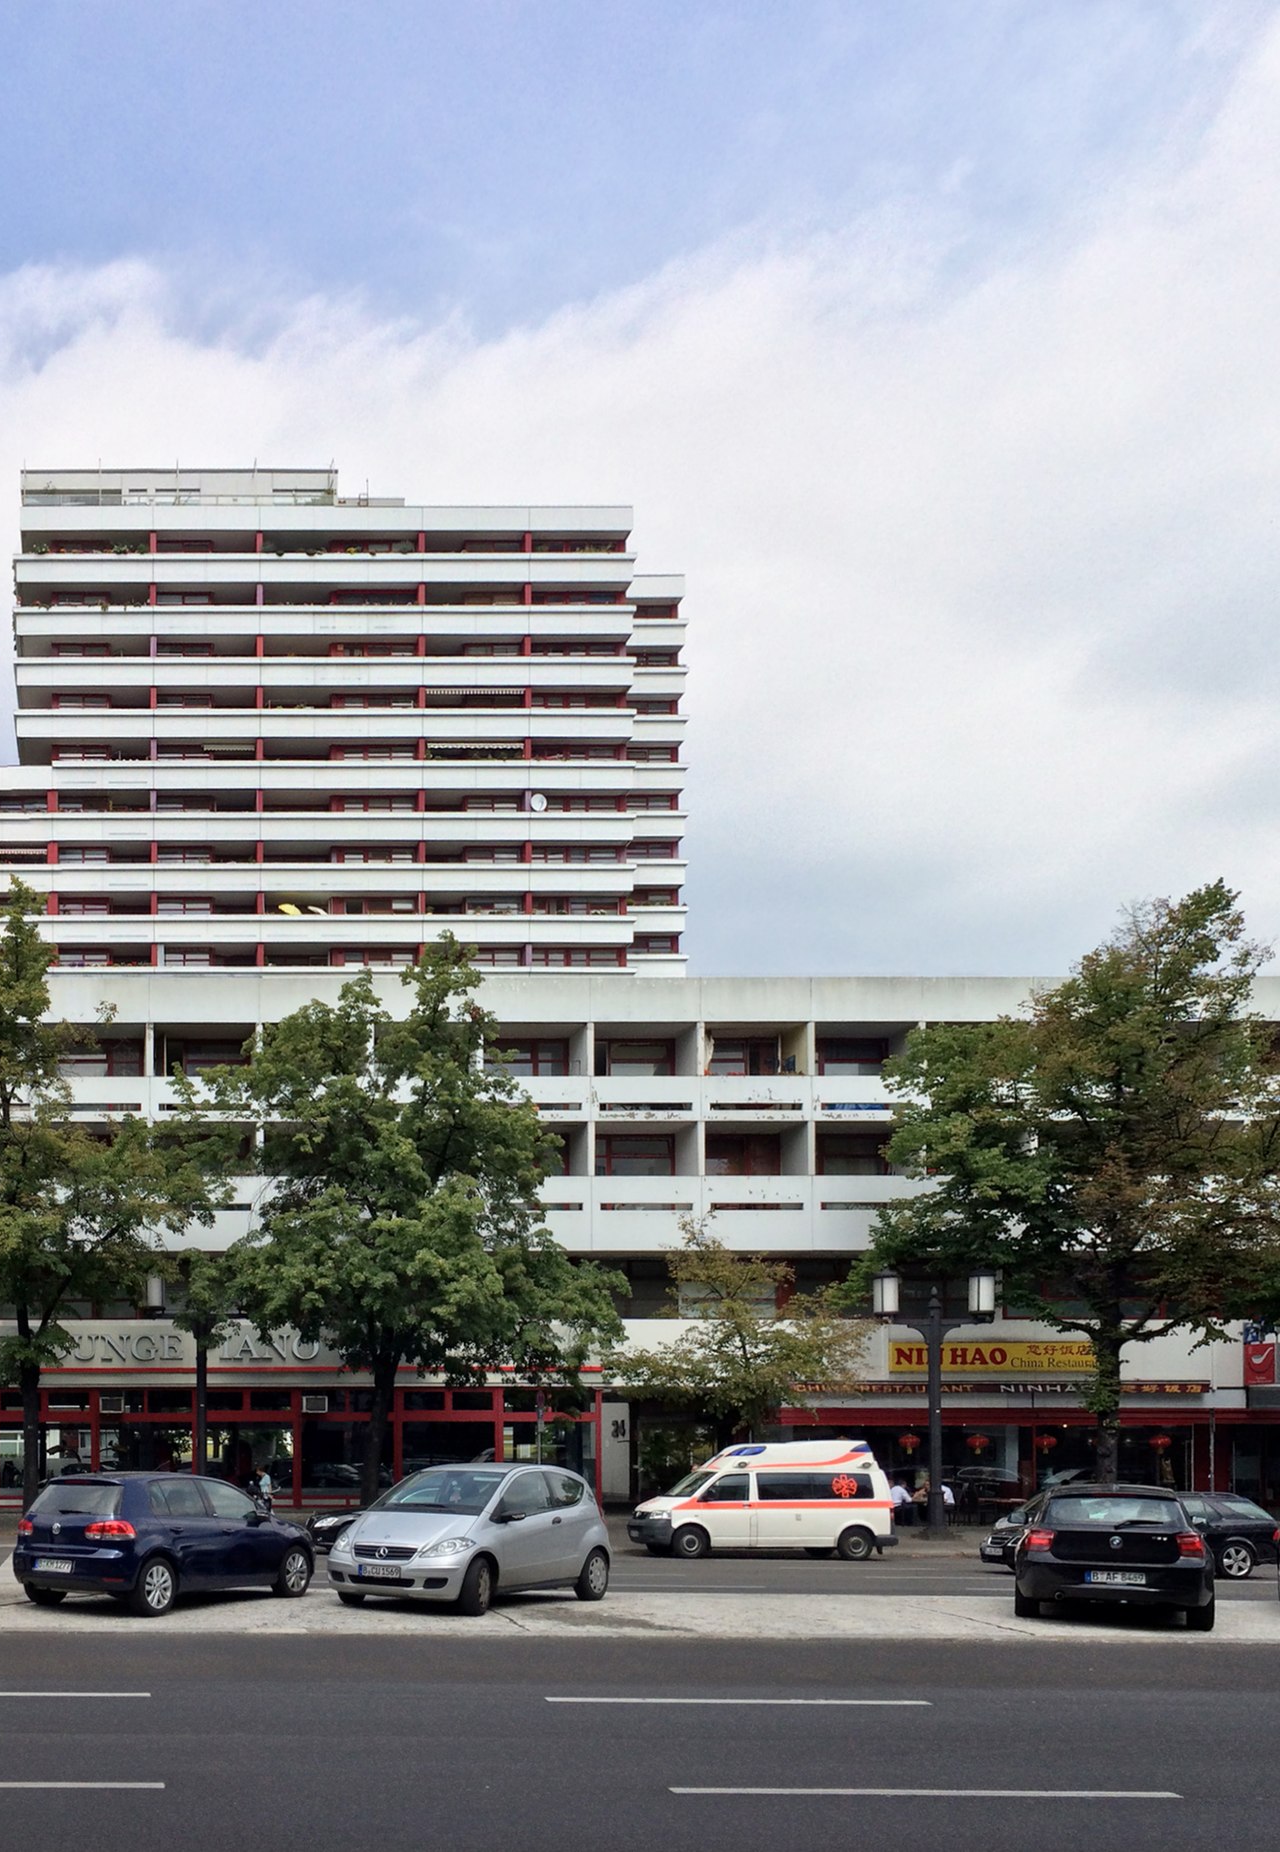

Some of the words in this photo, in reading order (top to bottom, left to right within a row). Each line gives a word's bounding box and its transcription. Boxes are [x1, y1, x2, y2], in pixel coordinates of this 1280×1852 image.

[57, 1334, 183, 1361] UNGE
[219, 1334, 320, 1361] IANO
[950, 1347, 1008, 1366] HAO
[1010, 1357, 1044, 1369] China
[859, 1384, 974, 1393] RESTAUANT
